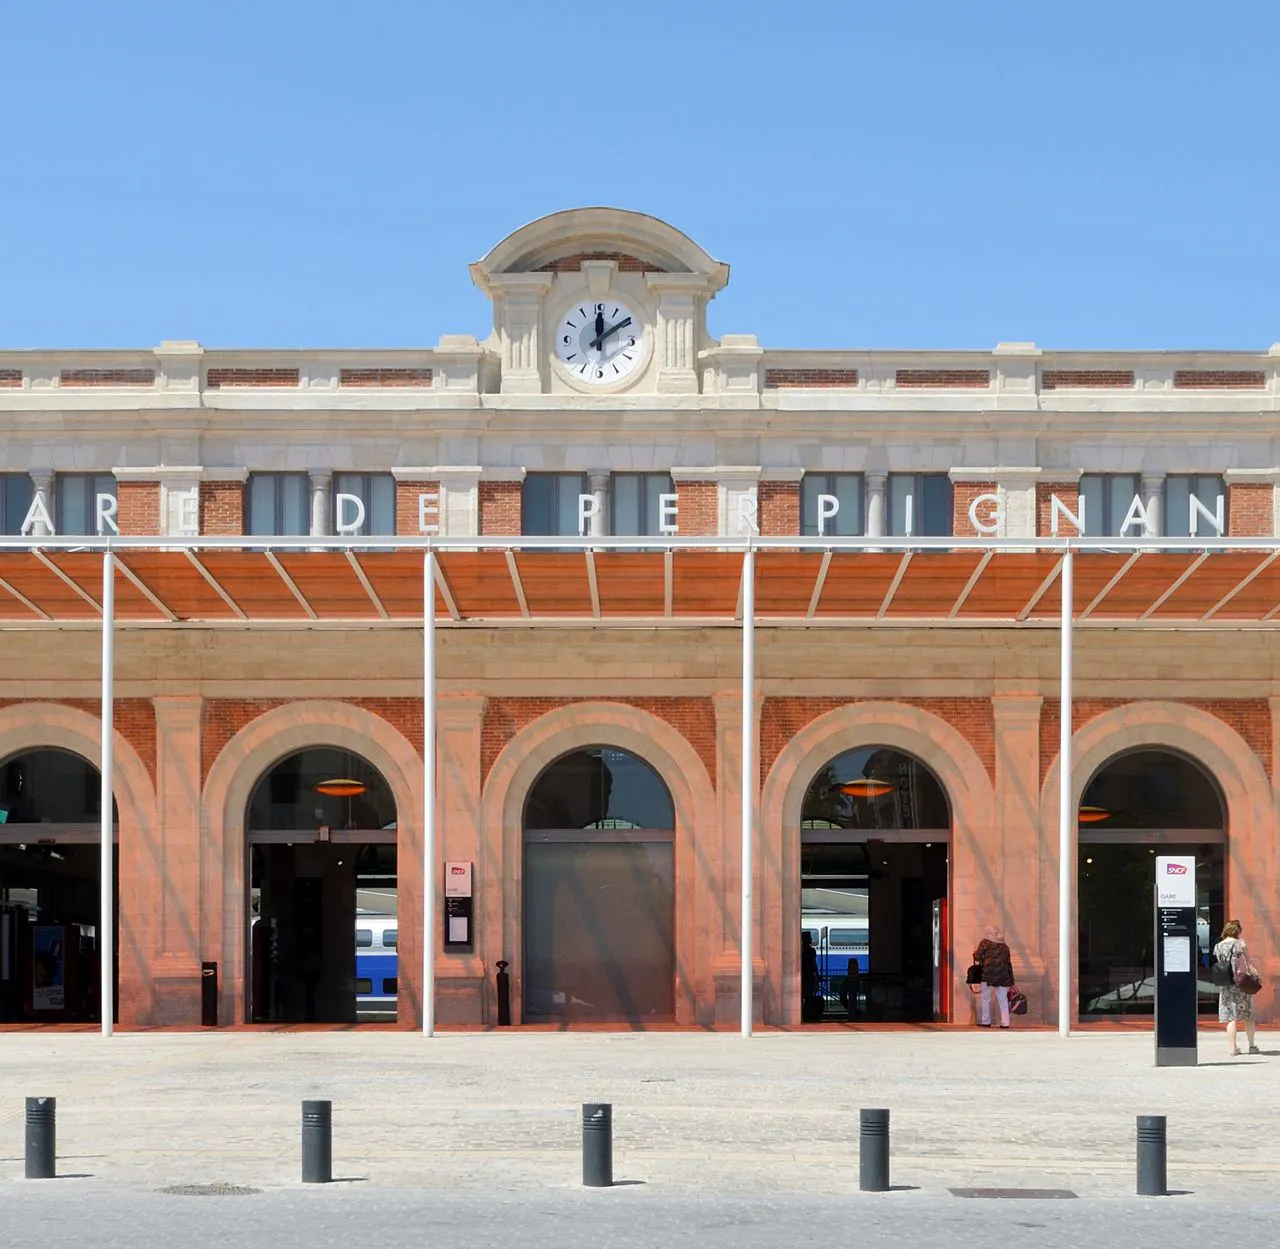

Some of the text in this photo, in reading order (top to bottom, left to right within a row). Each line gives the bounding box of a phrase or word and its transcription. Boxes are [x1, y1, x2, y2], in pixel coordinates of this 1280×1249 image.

[564, 335, 572, 346] 9
[627, 336, 636, 346] 3
[596, 367, 604, 378] 6
[336, 493, 439, 533] DE
[578, 492, 1225, 534] PERPIGNAN
